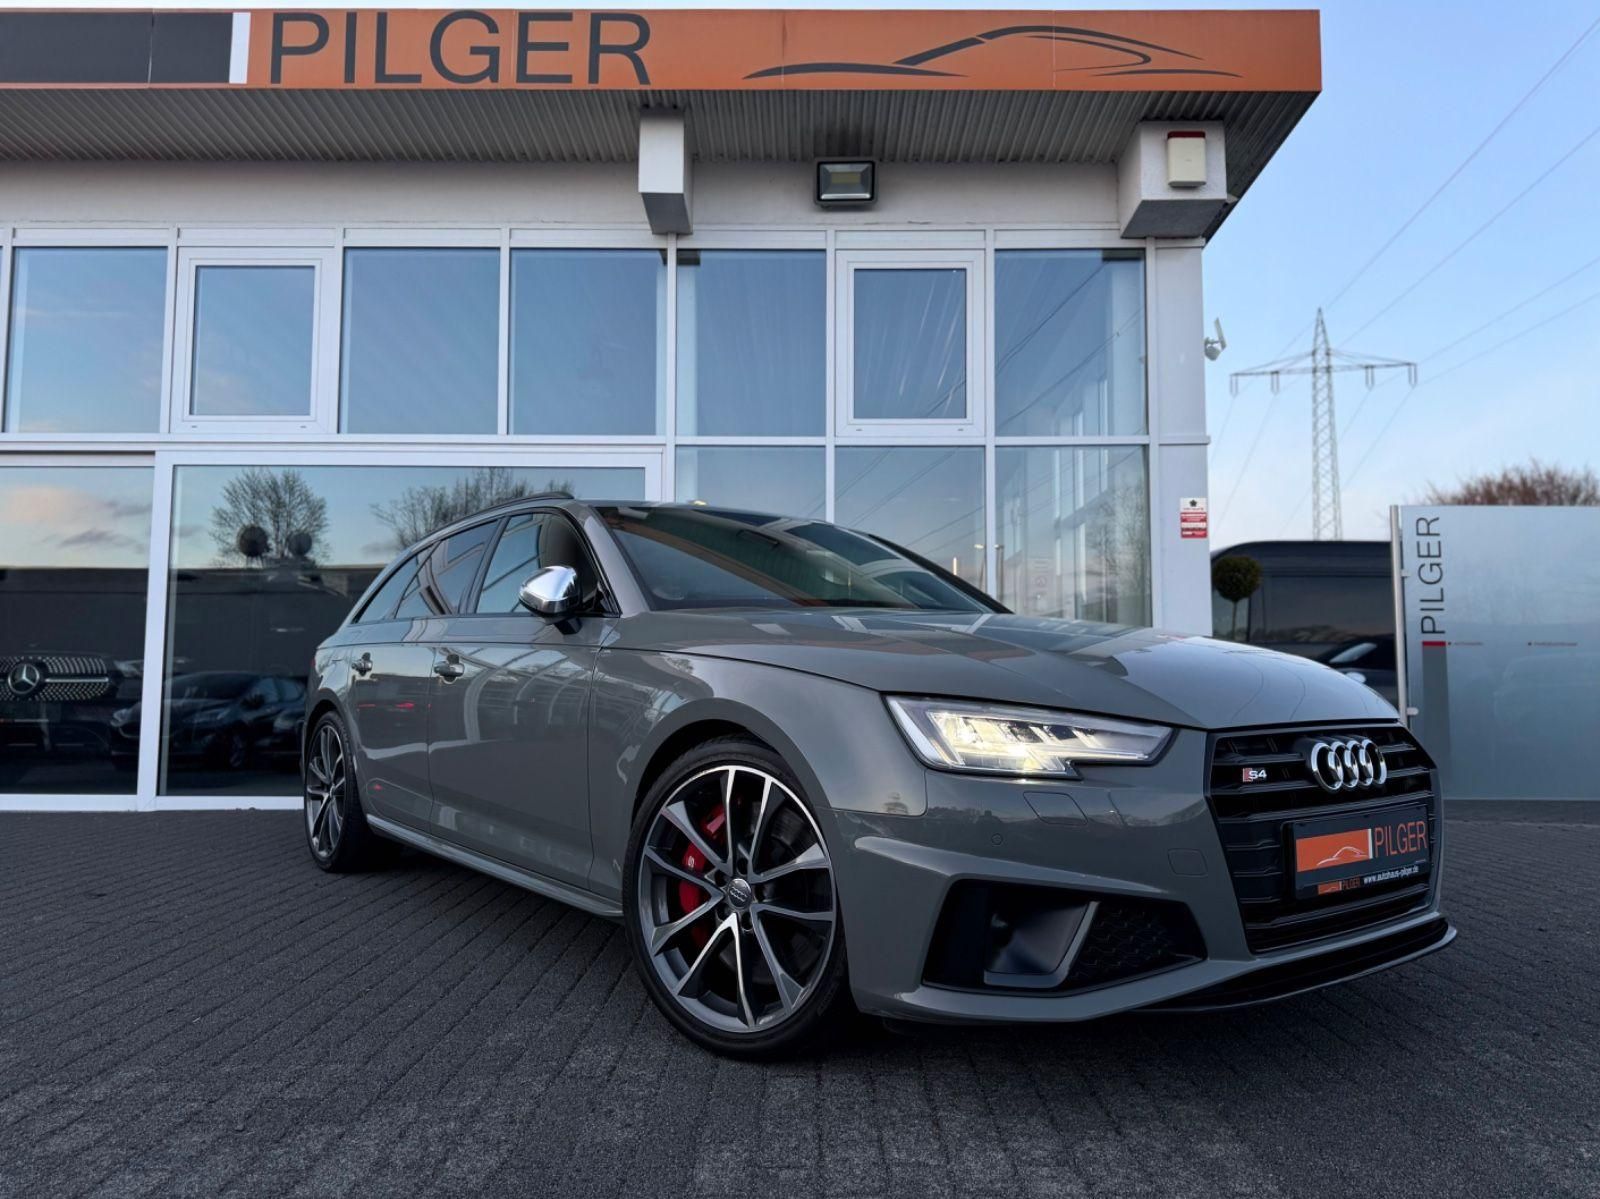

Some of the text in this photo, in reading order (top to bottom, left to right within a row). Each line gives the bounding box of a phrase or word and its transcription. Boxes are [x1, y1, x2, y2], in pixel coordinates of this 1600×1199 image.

[270, 10, 651, 85] PILGER
[1416, 517, 1446, 634] PILGER
[1248, 769, 1267, 780] S4
[1374, 821, 1427, 858] PILGER
